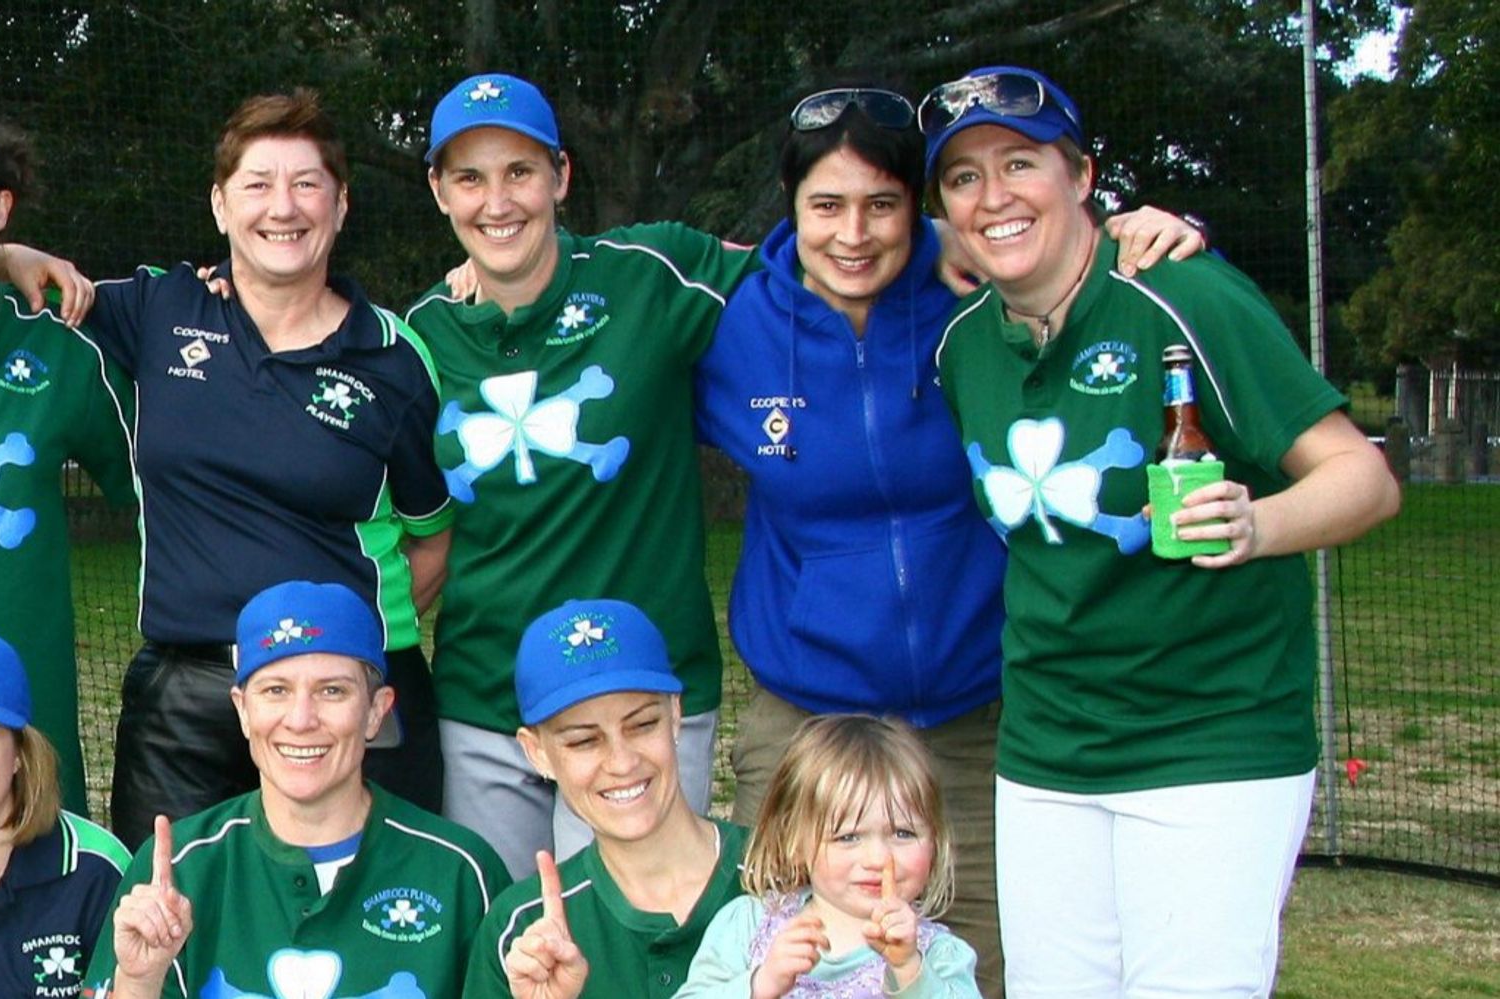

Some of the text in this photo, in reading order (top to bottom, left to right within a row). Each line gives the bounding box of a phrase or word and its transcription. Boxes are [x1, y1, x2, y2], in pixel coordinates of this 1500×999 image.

[172, 326, 230, 344] COOPER'S
[187, 346, 203, 360] C
[167, 366, 208, 382] HOTEL
[315, 366, 376, 403] SHAMROCK
[305, 404, 350, 430] PLAYERS
[768, 417, 784, 434] C
[363, 887, 443, 914] SHAMROCK PLAYERS
[22, 934, 82, 954] SHAMROC
